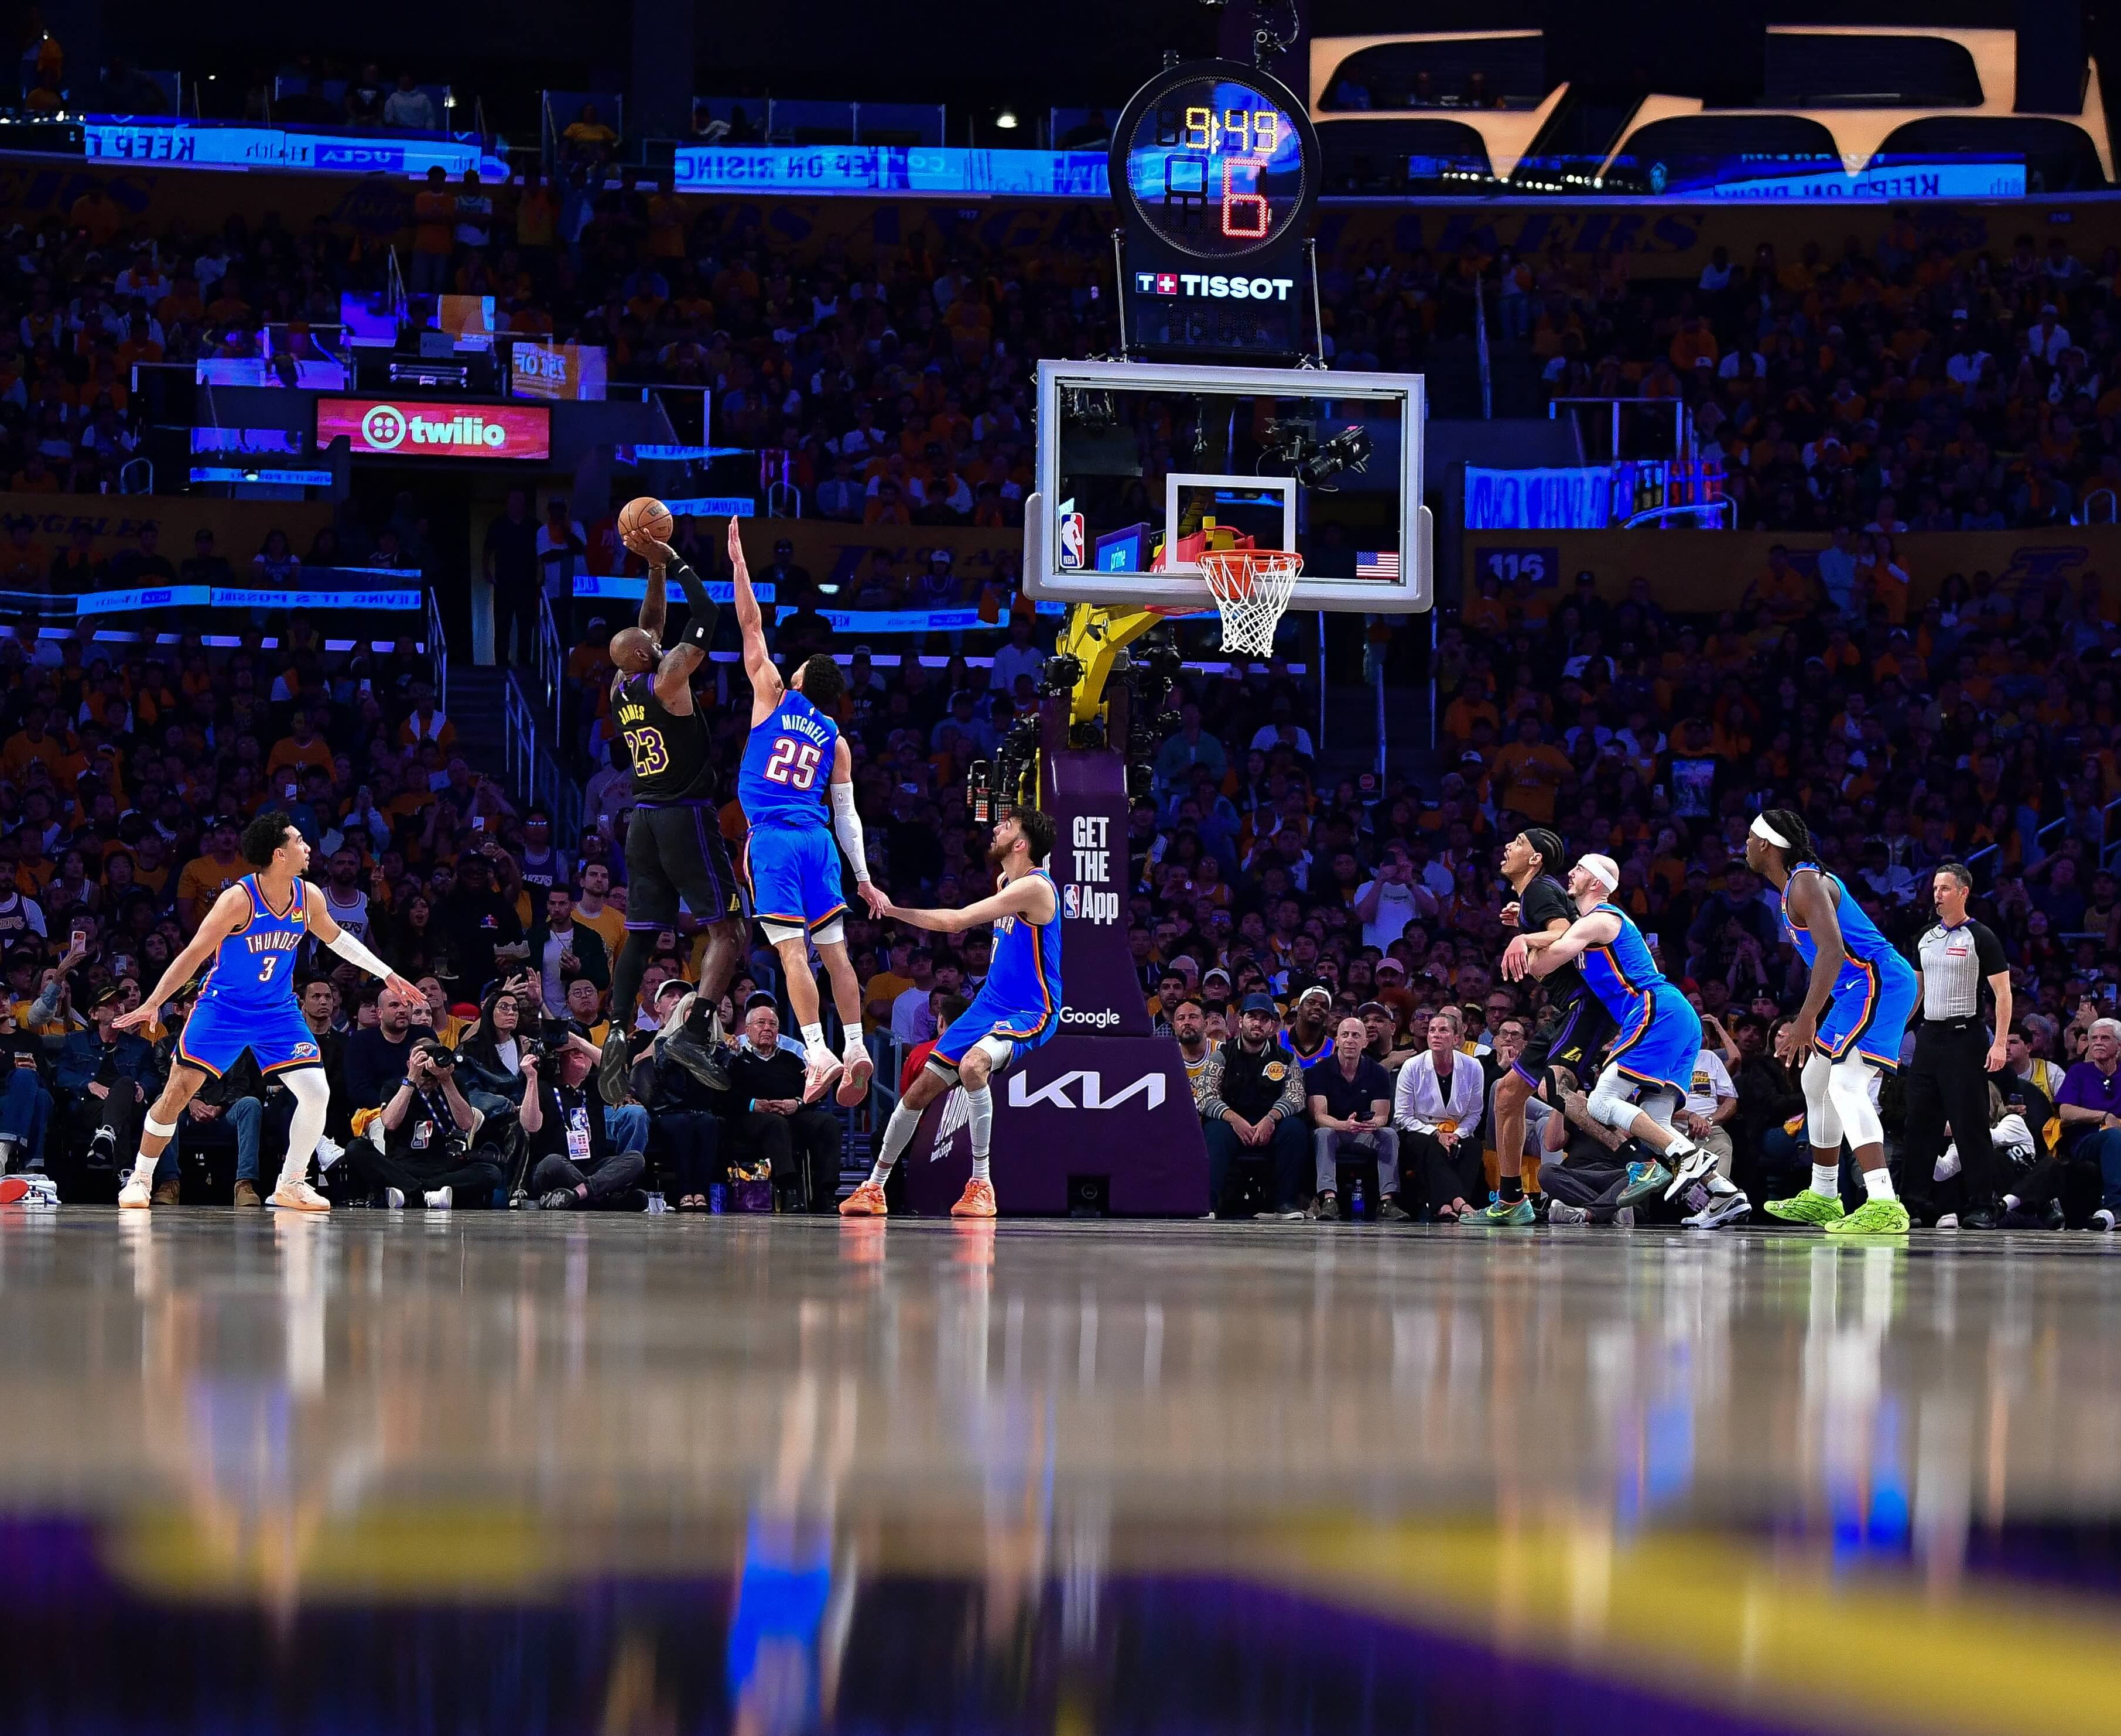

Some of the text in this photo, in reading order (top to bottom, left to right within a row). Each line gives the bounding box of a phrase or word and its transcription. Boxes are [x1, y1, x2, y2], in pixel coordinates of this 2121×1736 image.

[1185, 107, 1278, 153] 9:49
[1223, 158, 1268, 237] 6
[1181, 274, 1294, 300] TISSOT
[409, 415, 506, 447] twilio
[618, 704, 645, 725] JAMES
[782, 714, 830, 747] MITCHELL
[624, 726, 669, 777] 23
[765, 736, 823, 791] 25
[1073, 816, 1109, 848] GET
[1072, 850, 1110, 881] THE
[1082, 885, 1118, 925] App
[258, 956, 278, 982] 3
[1059, 1006, 1120, 1028] Google
[1008, 1069, 1166, 1111] KIA
